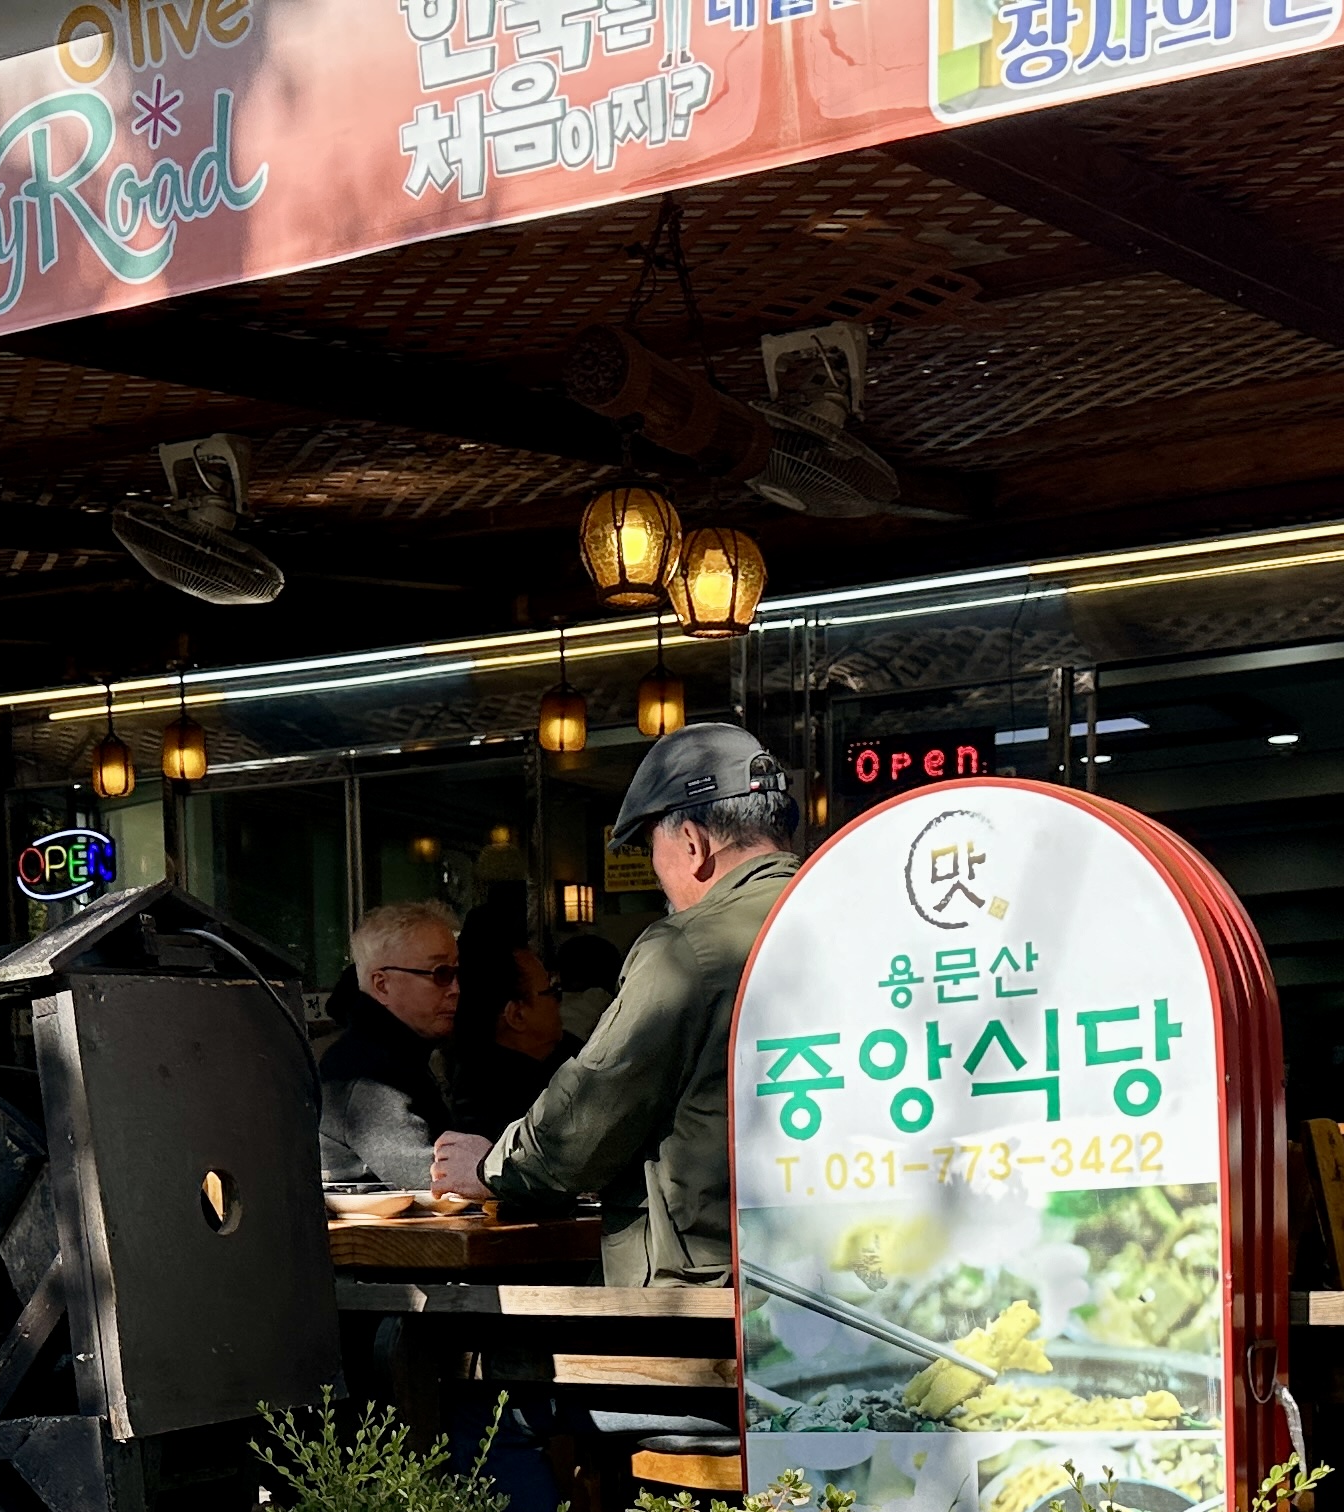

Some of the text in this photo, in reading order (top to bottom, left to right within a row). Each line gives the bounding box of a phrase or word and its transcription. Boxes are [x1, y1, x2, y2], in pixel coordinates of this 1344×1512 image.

[402, 60, 712, 198] 처음이지?
[856, 746, 978, 783] Open
[18, 842, 115, 885] OPEN
[931, 840, 987, 912] 맛
[878, 941, 1040, 1009] 용문산
[755, 997, 1183, 1141] 중앙식당
